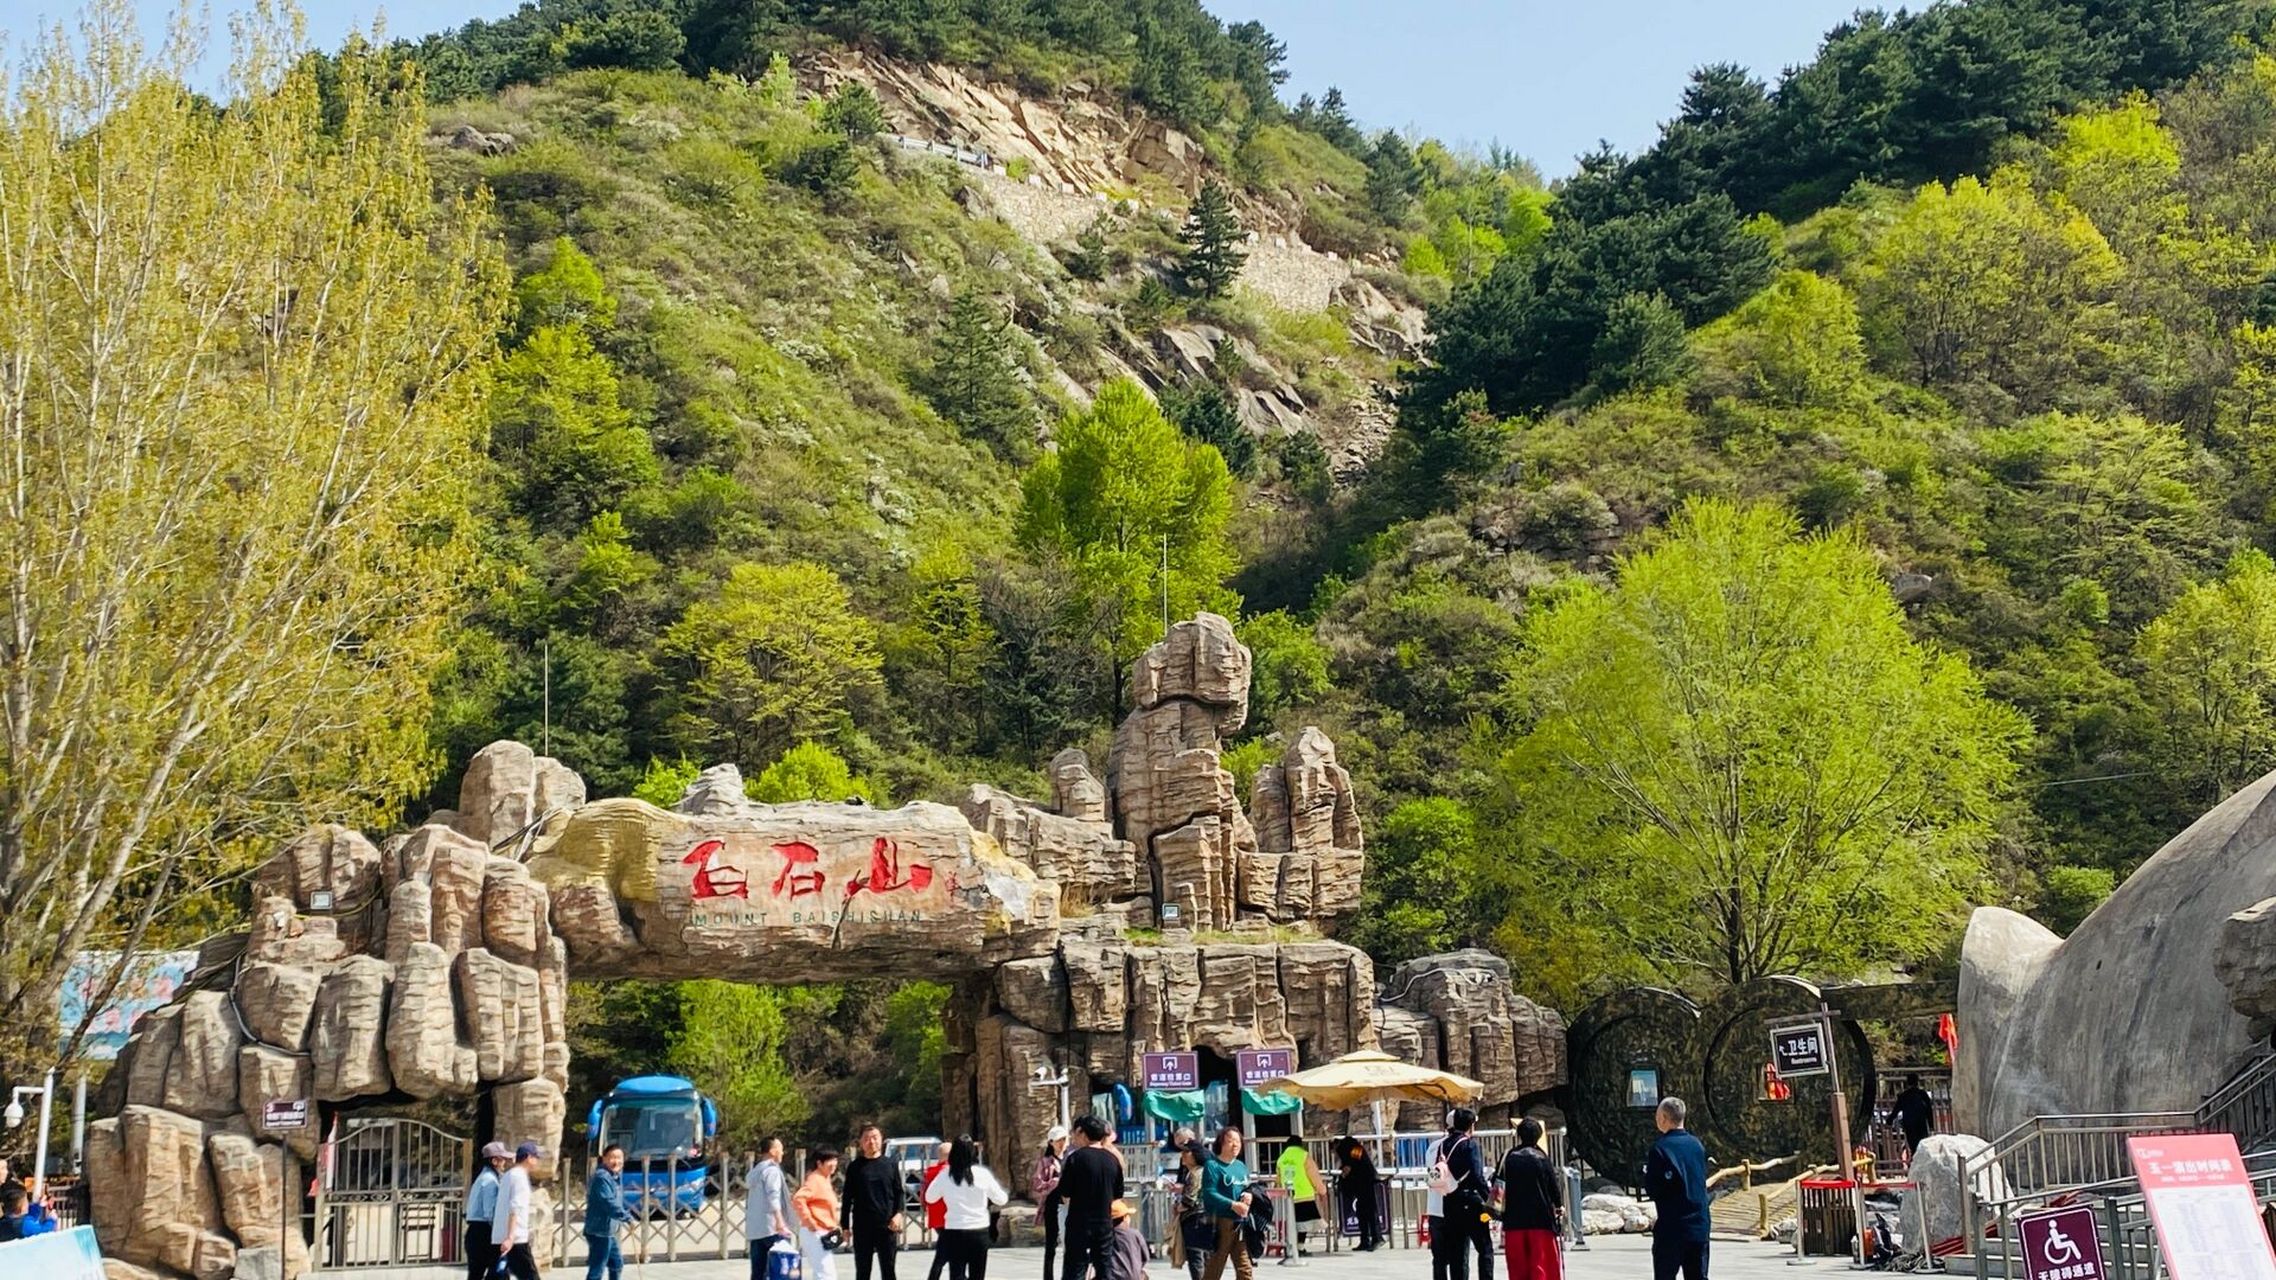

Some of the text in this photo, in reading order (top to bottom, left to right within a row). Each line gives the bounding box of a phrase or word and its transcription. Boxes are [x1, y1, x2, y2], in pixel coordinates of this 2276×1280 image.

[682, 837, 933, 900] 白石山
[690, 911, 767, 926] MOUNT
[1788, 1037, 1818, 1056] 卫生间
[2038, 1262, 2096, 1280] 无障碍通道
